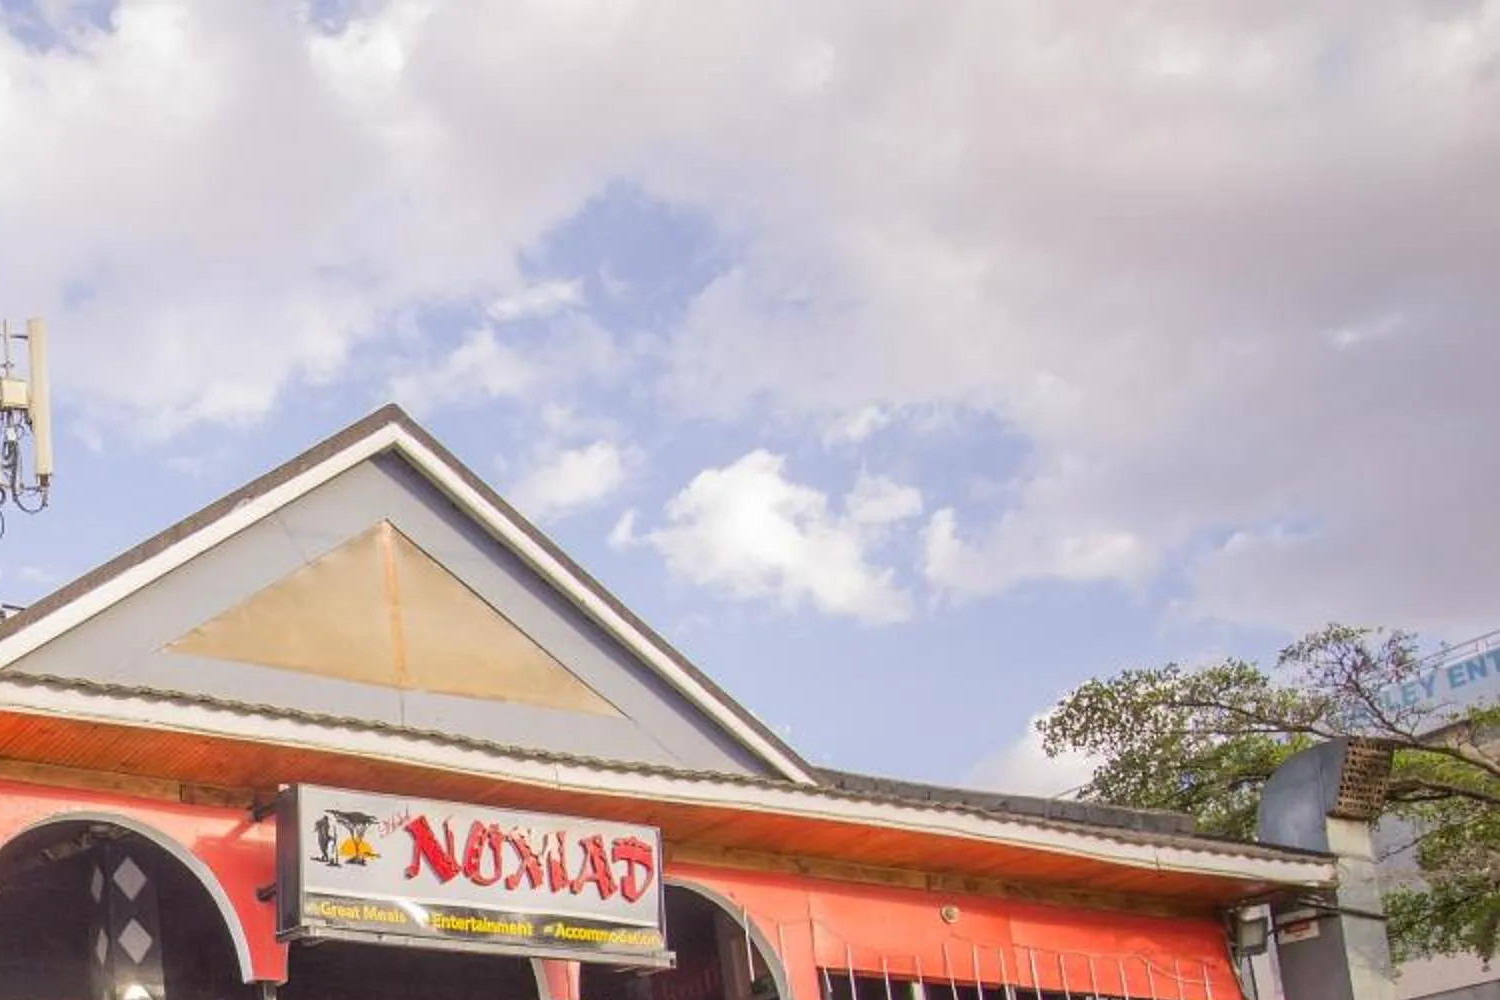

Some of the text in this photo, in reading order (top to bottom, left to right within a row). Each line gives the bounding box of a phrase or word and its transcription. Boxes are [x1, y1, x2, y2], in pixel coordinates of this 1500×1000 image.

[403, 812, 656, 903] NOMAD
[320, 901, 361, 922] Great
[363, 904, 407, 925] Meals
[432, 912, 533, 937] Entertainment
